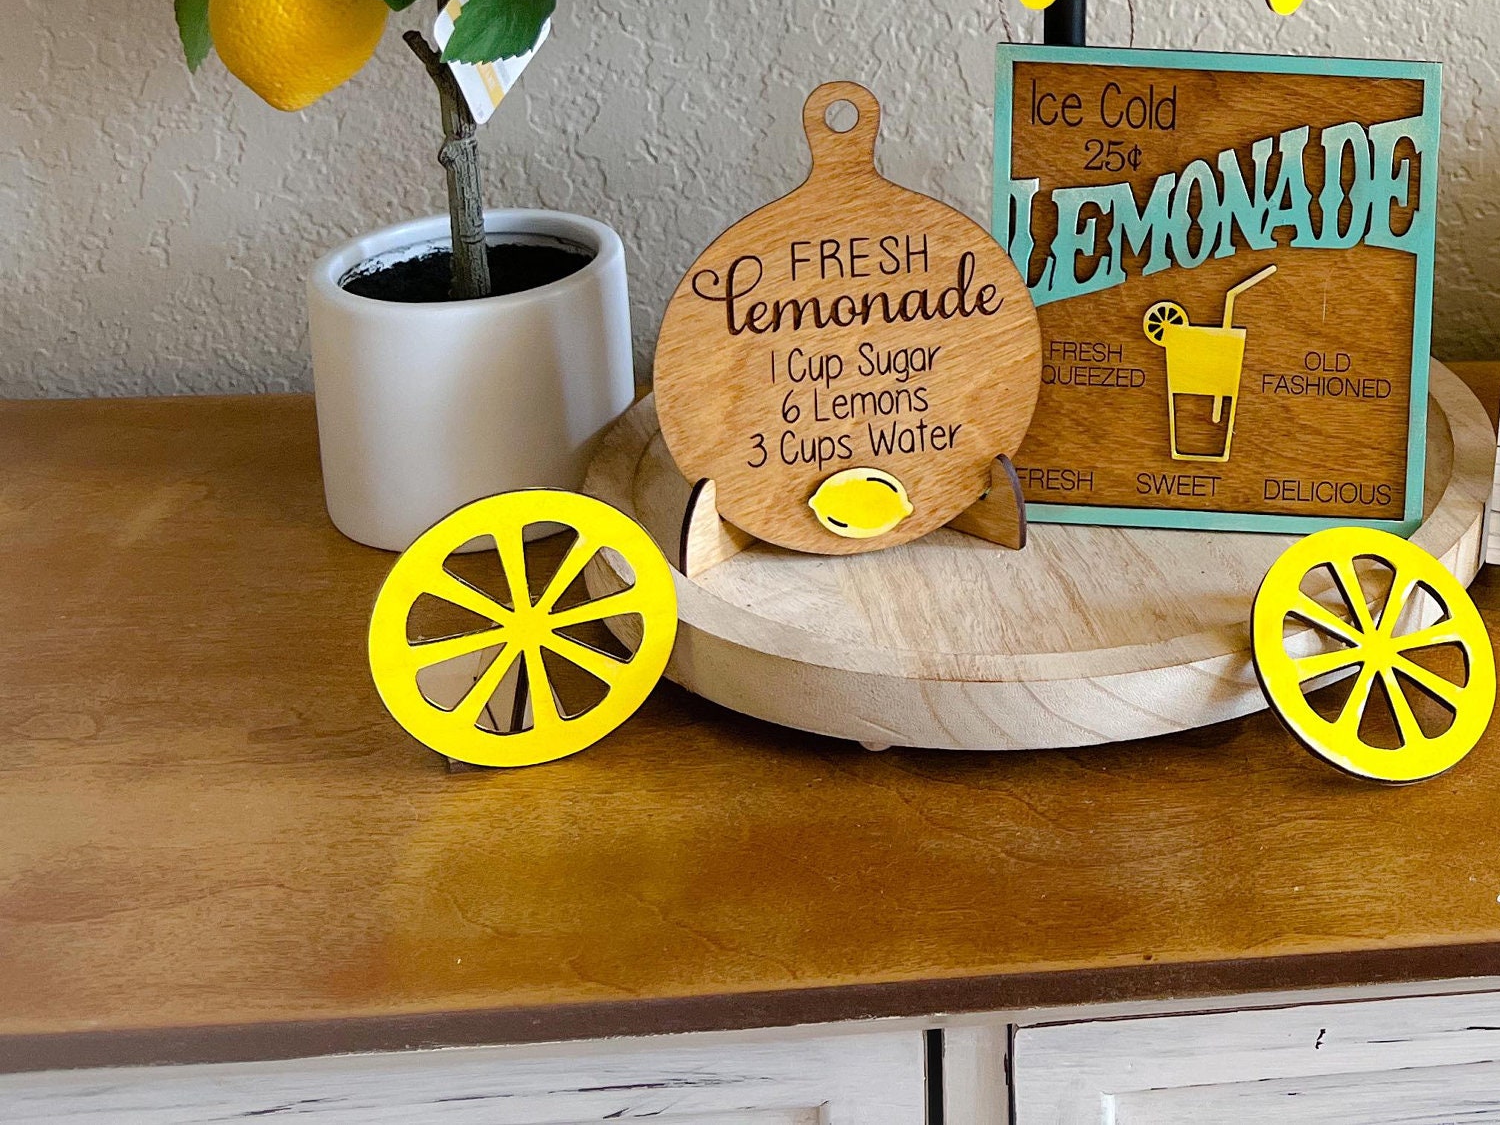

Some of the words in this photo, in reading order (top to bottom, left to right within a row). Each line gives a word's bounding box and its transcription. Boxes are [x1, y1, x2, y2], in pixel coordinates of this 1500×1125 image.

[1030, 78, 1084, 129] Ice
[1099, 81, 1178, 131] Cold
[1083, 138, 1143, 172] 25¢
[1008, 113, 1424, 307] LEMONADE
[790, 233, 930, 280] FRESH
[787, 348, 843, 389] Cup
[858, 342, 942, 383] Sugar
[1050, 340, 1123, 362] FRESH
[1304, 351, 1352, 373] OLD
[1041, 364, 1146, 388] QUEEZED
[1261, 374, 1393, 399] FASHIONED
[781, 389, 801, 424] 6
[813, 386, 929, 422] Lemons
[746, 433, 768, 468] 3
[780, 432, 854, 469] Cups
[867, 419, 963, 457] Water
[1016, 467, 1093, 491] FRESH
[1135, 472, 1222, 497] SWEET
[1263, 478, 1393, 506] DELICIOUS
